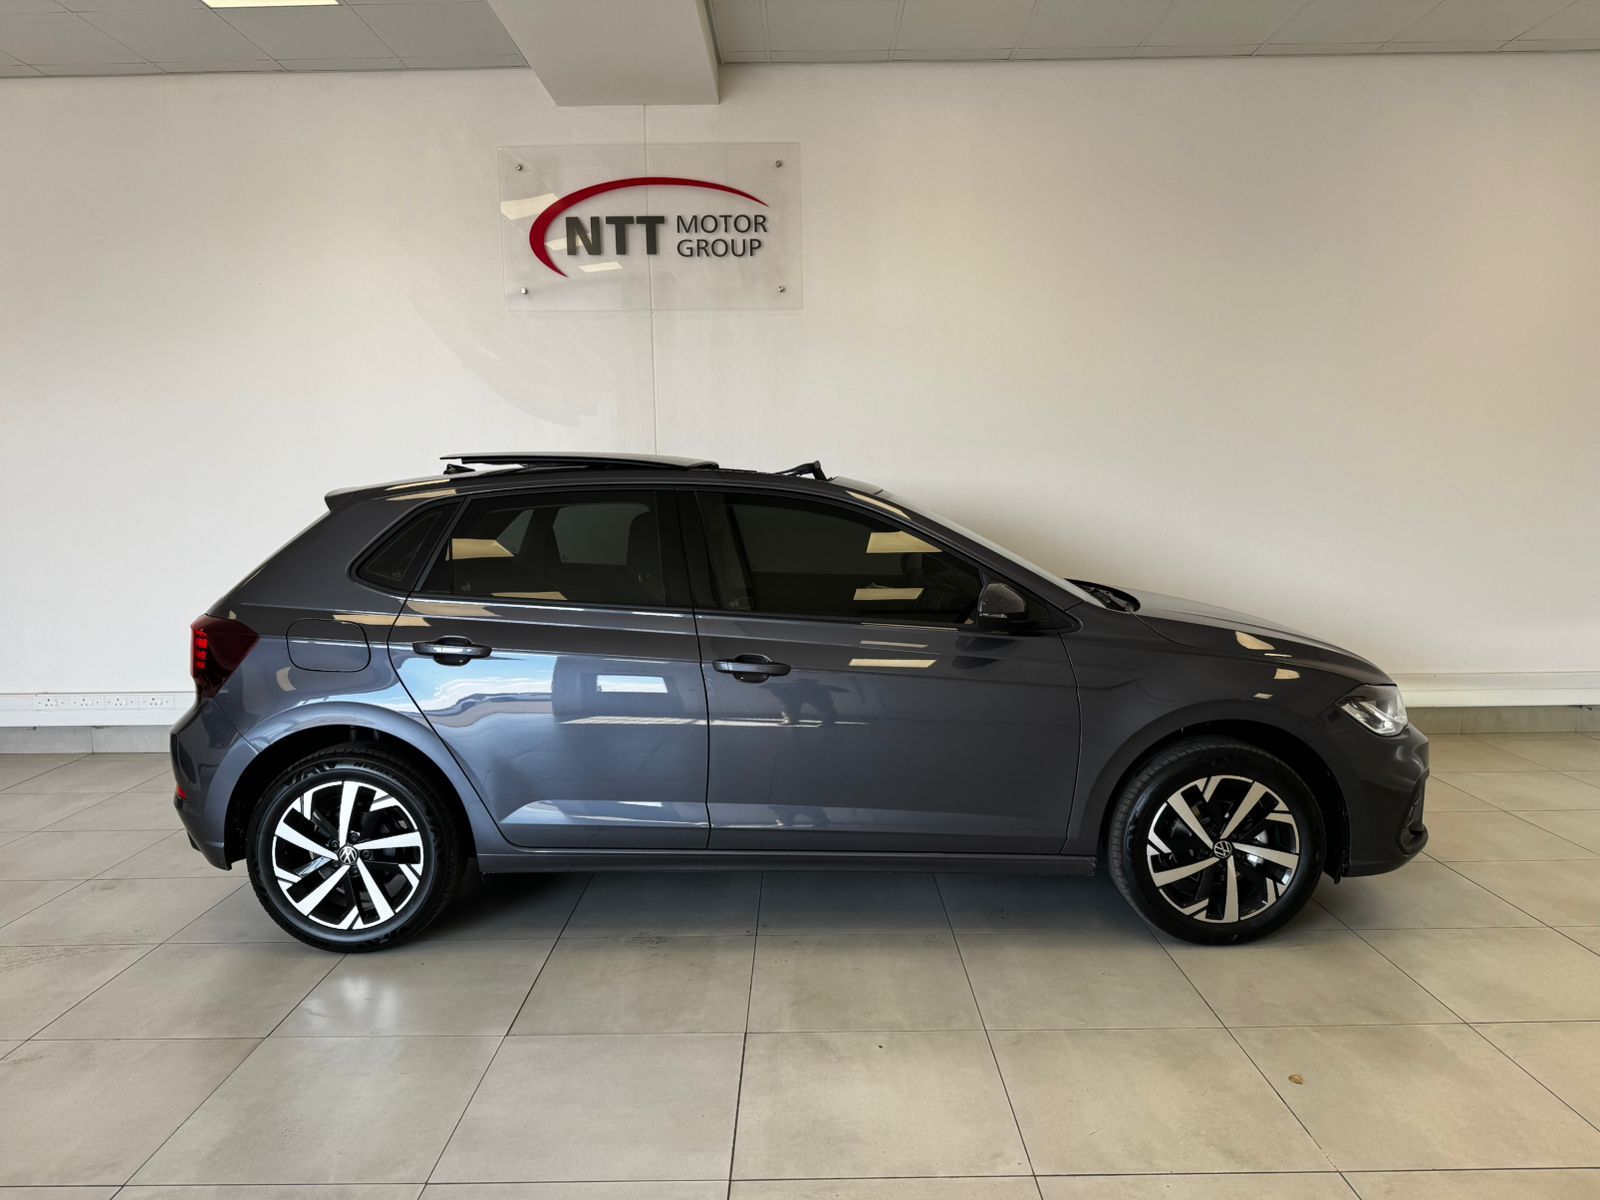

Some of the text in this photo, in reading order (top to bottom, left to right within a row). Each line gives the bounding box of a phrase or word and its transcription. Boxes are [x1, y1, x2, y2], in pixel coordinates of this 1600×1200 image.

[676, 214, 768, 233] MOTOR
[565, 216, 665, 256] NTT
[677, 238, 763, 257] GROUP
